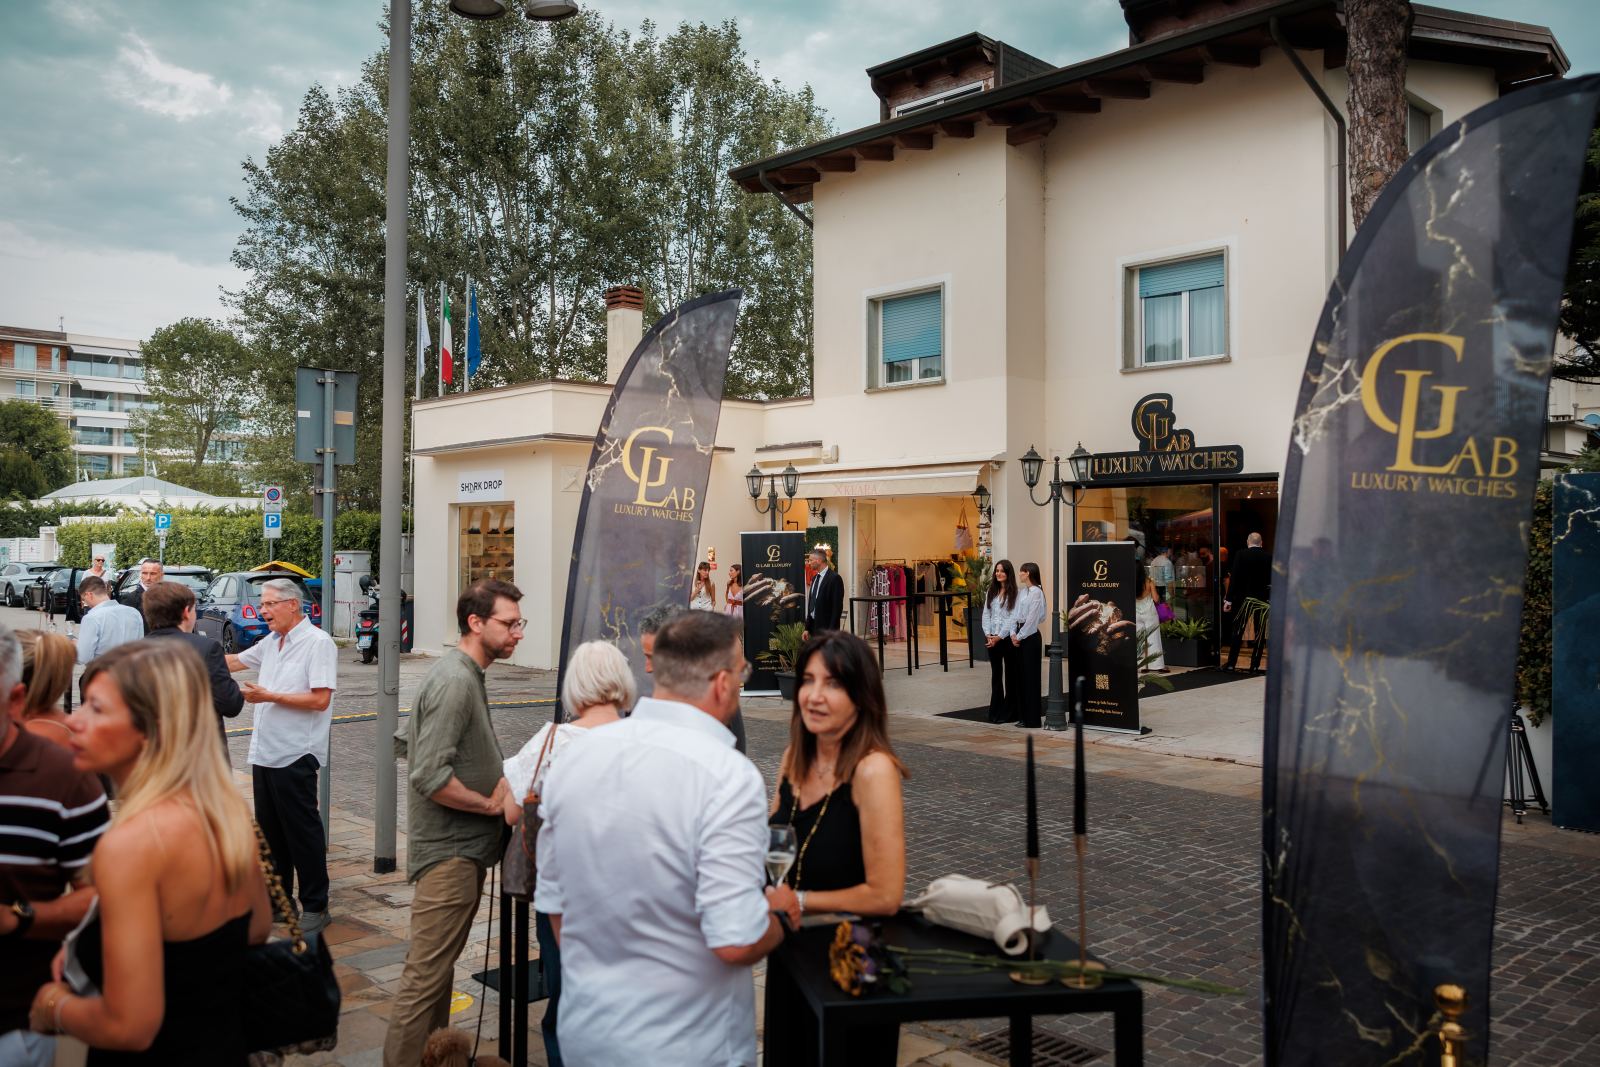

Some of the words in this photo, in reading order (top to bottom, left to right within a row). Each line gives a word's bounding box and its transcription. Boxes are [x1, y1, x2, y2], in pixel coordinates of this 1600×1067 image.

[1094, 455, 1154, 475] LUXURY
[1158, 450, 1238, 471] WATCHES
[483, 480, 503, 490] DROP
[1351, 471, 1422, 492] LUXURY
[1429, 477, 1517, 498] WATCHES
[614, 503, 649, 517] LUXURY
[651, 508, 694, 522] WATCHES
[158, 515, 168, 527] P
[268, 515, 278, 527] P
